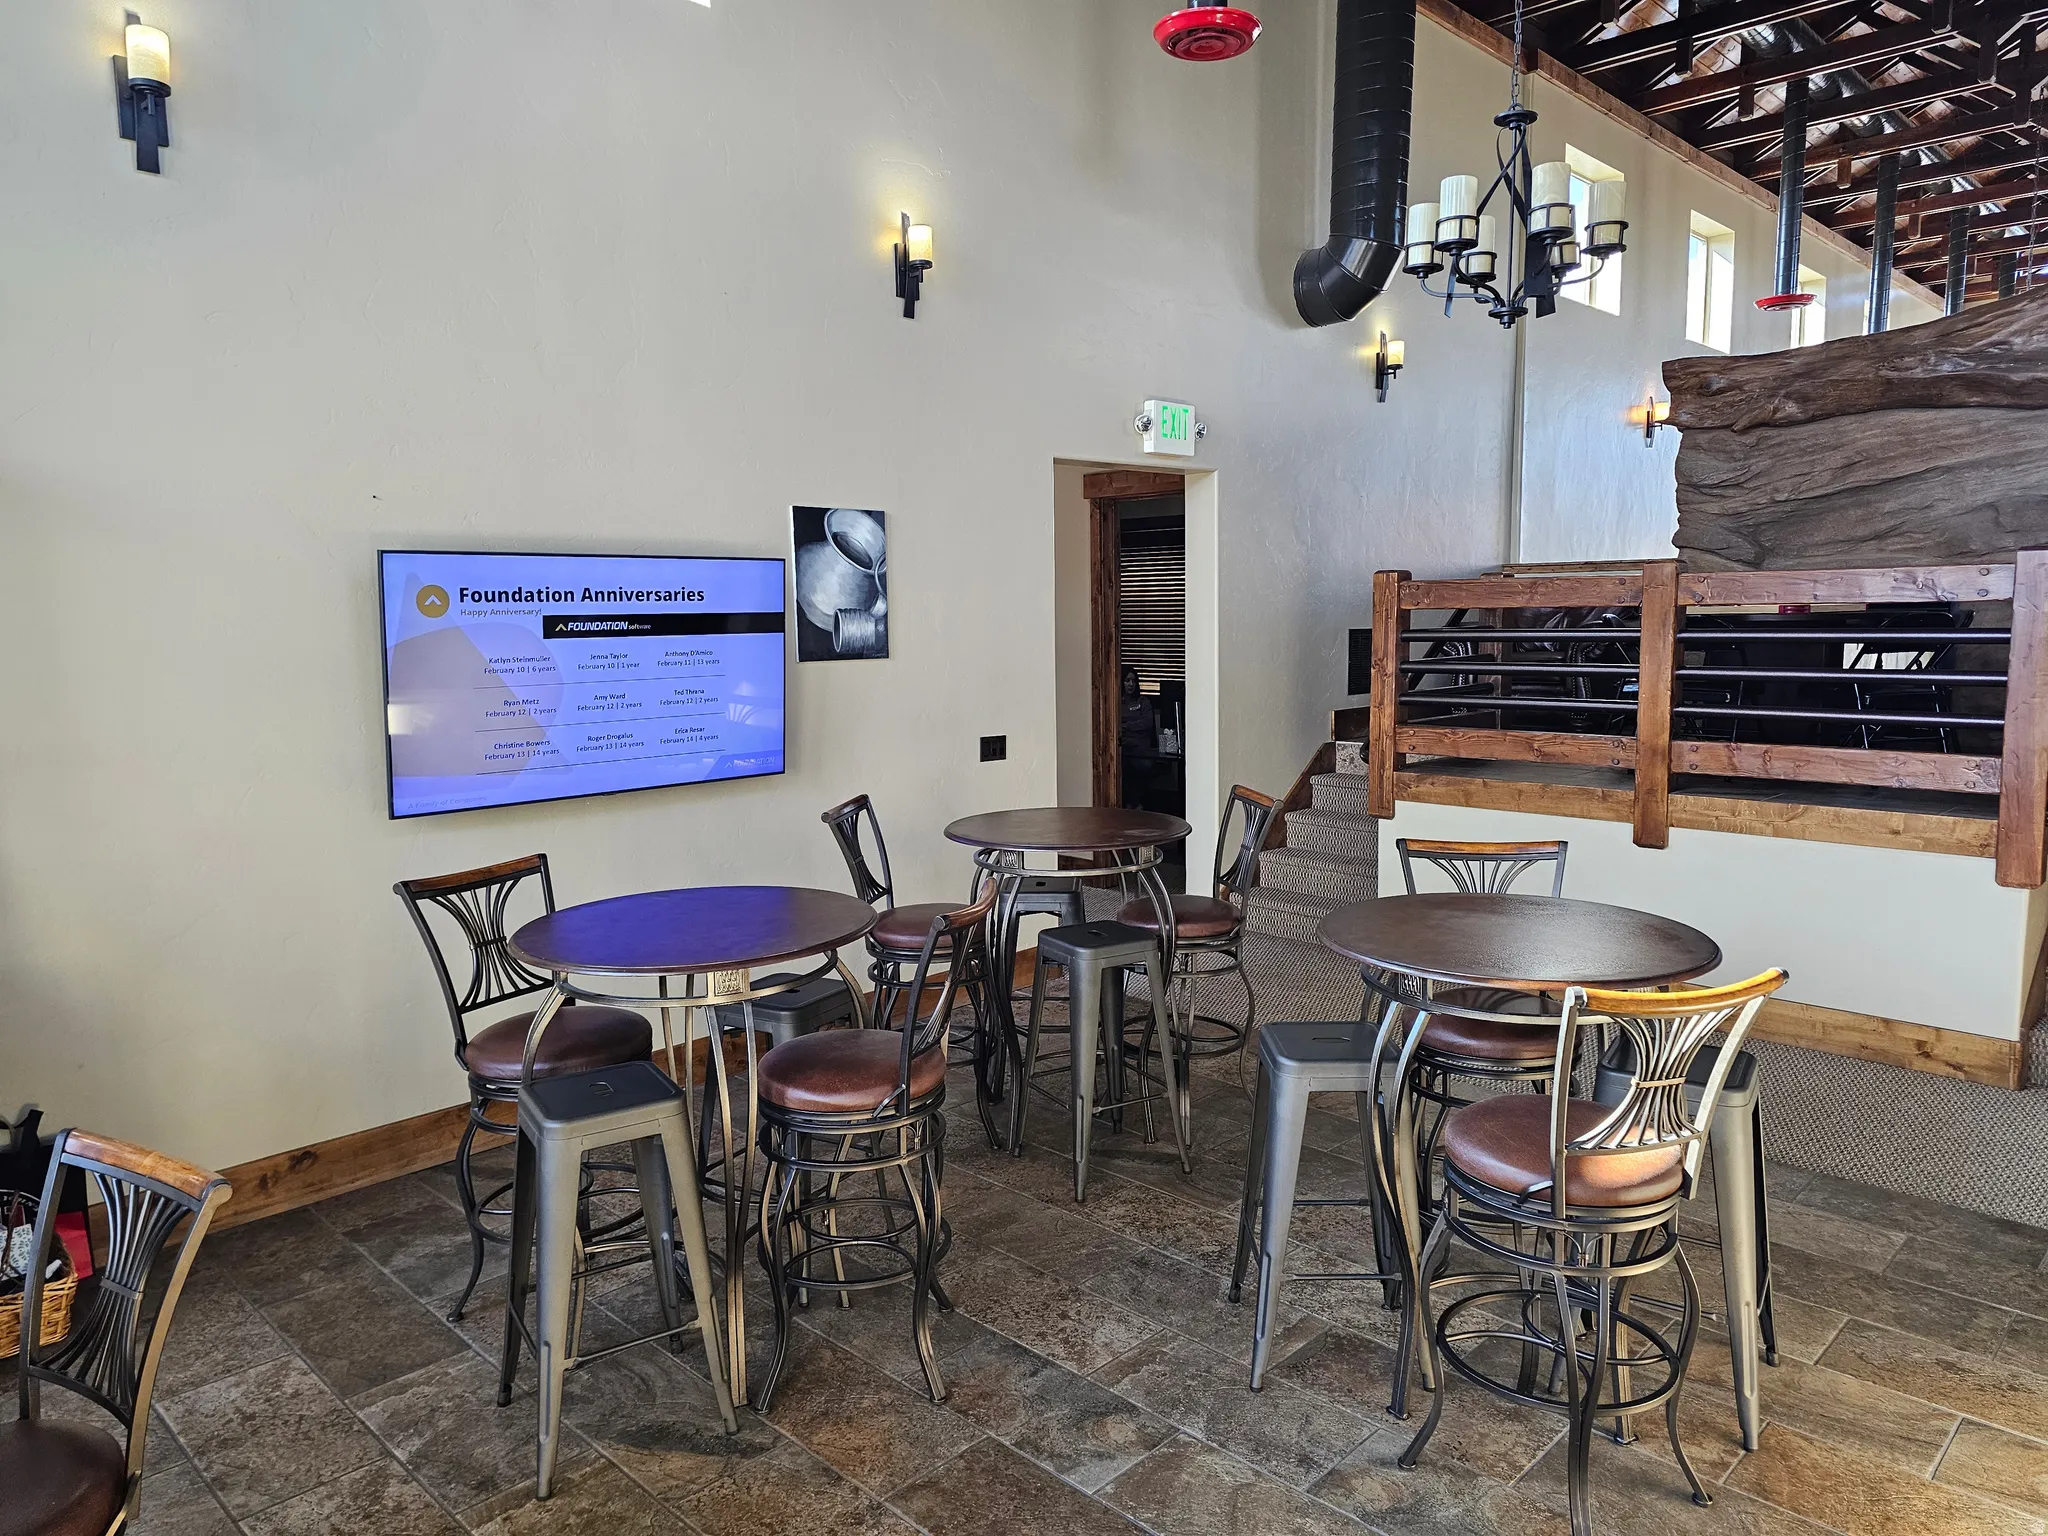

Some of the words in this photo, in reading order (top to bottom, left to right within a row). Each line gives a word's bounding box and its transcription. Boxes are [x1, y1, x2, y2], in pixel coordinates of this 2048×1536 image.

[1161, 405, 1189, 441] EXIT
[459, 586, 575, 603] Foundation
[580, 586, 705, 602] Anniversaries
[460, 609, 488, 617] Happy
[490, 608, 542, 616] Anniversary!
[567, 621, 629, 631] FOUNDATION
[488, 657, 511, 665] Katlyn
[577, 663, 606, 671] February
[577, 704, 606, 712] February
[485, 710, 517, 718] February
[674, 727, 688, 735] Erica
[628, 741, 645, 749] years
[659, 737, 686, 745] February
[494, 742, 525, 750] Christine
[484, 753, 516, 761] February
[532, 749, 541, 757] 14
[542, 748, 560, 756] years
